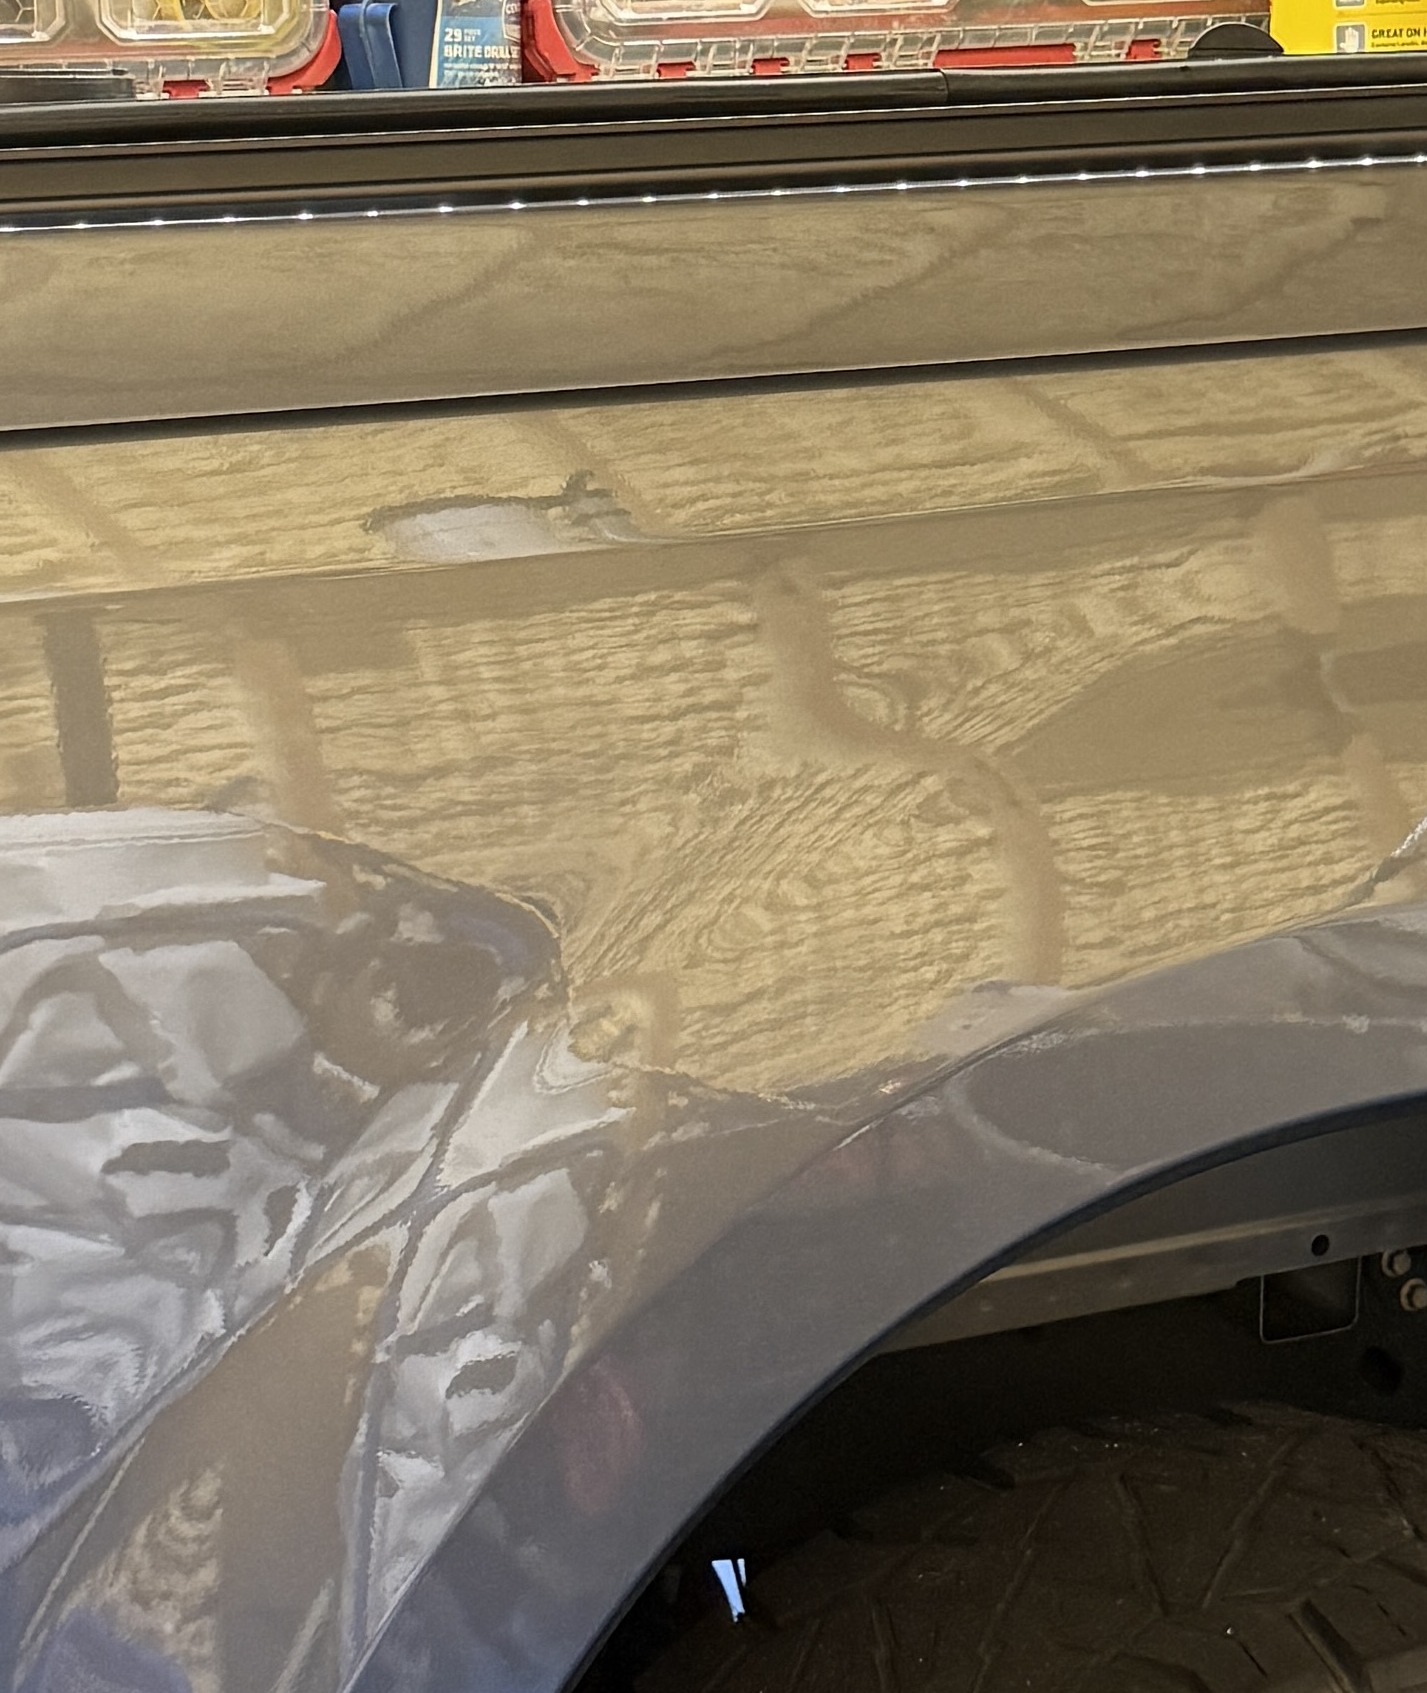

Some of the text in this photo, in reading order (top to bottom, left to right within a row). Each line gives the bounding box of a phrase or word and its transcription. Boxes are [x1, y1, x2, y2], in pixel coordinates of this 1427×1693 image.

[444, 27, 462, 42] 29
[1372, 28, 1404, 39] GREAT
[1406, 27, 1421, 38] ON
[443, 44, 482, 58] BRITE
